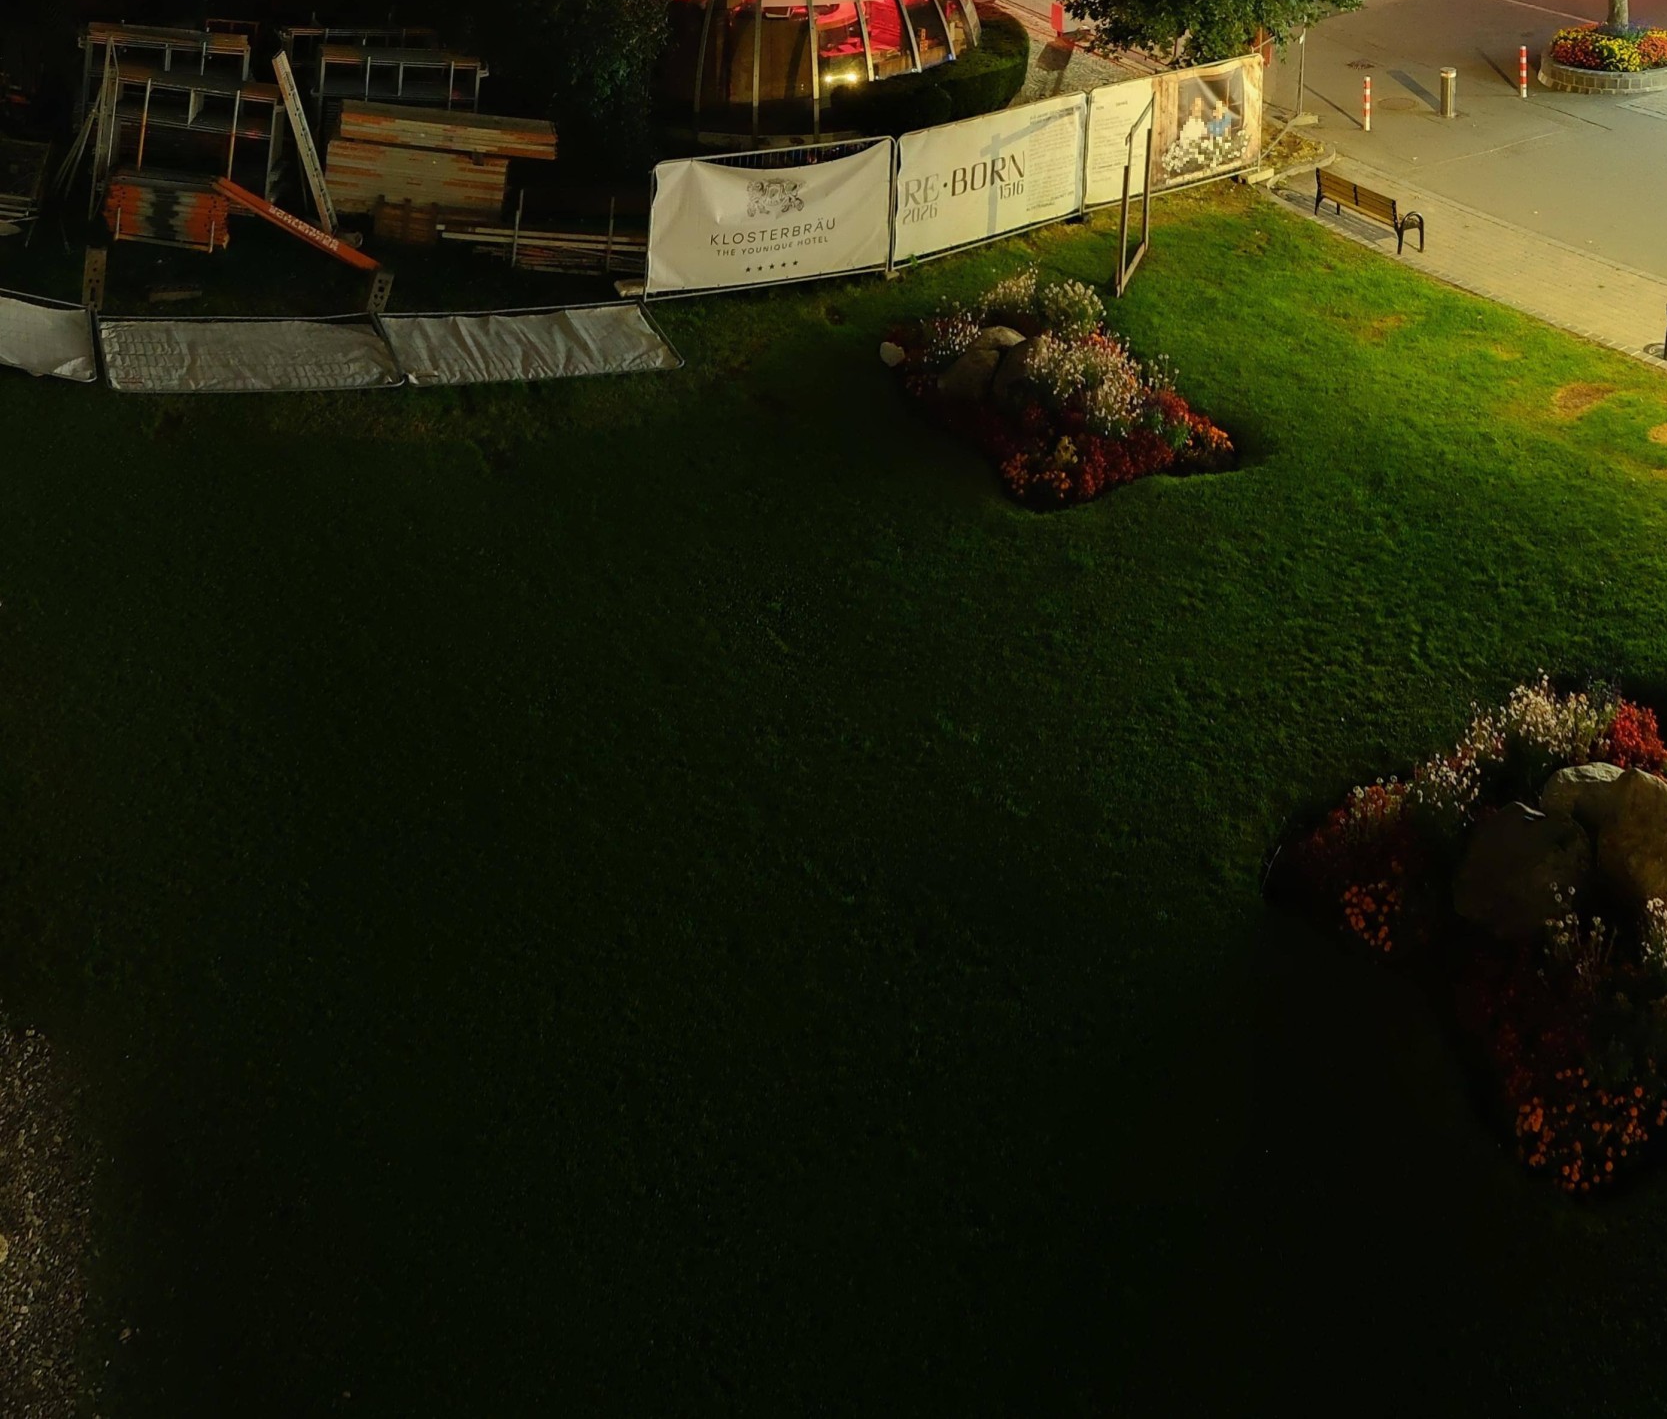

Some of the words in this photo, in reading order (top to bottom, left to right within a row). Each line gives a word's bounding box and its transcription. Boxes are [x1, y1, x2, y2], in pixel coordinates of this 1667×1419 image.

[999, 180, 1025, 201] 1516
[902, 202, 938, 226] 2026
[710, 217, 837, 246] KLOSTERBRÄU
[717, 248, 737, 257] THE
[741, 240, 794, 255] YOUNIQUE
[797, 235, 830, 247] HOTEL
